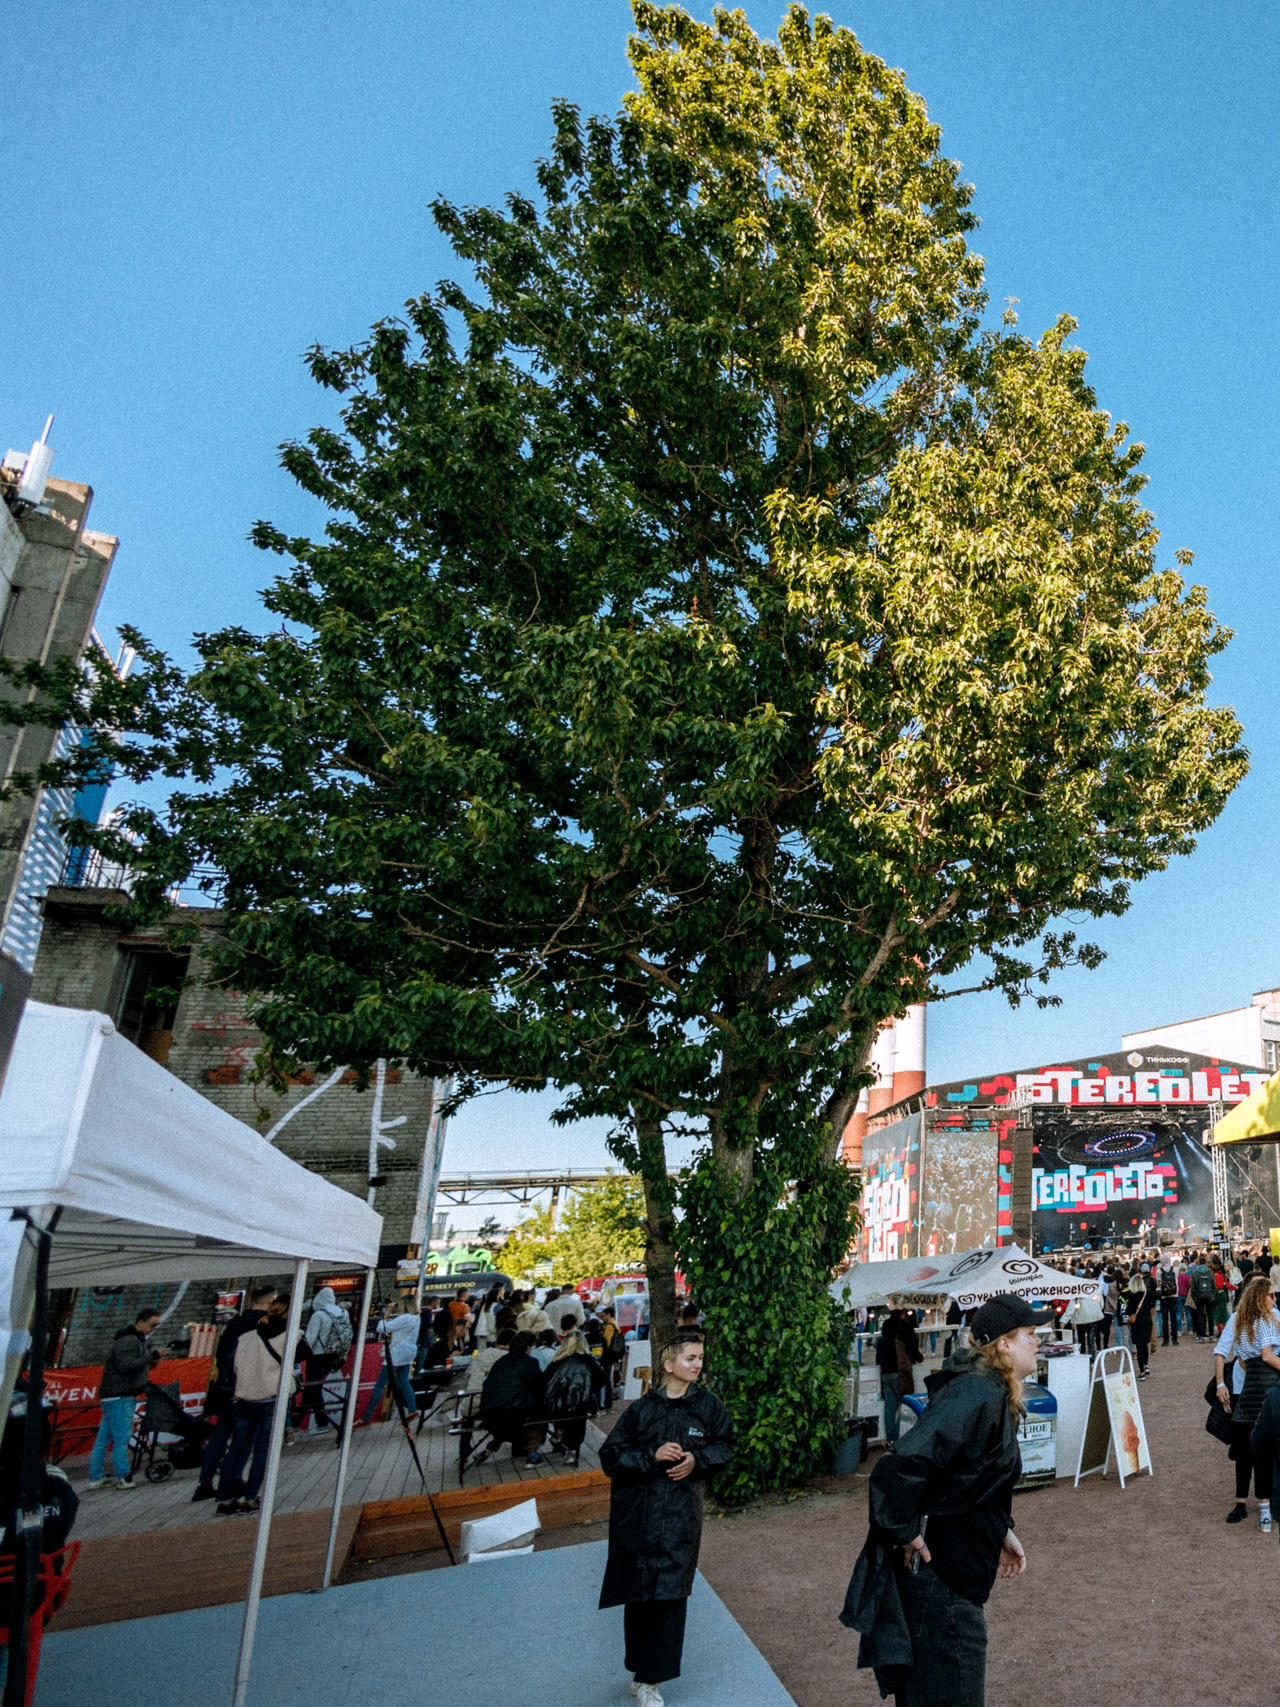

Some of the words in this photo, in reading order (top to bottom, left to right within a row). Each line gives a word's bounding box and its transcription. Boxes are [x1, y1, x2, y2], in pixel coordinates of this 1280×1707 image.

[1015, 1070, 1271, 1103] STEREOLET
[1032, 1162, 1163, 1210] TEREOLETO
[425, 1283, 453, 1291] STREET
[43, 1386, 97, 1402] AVEN
